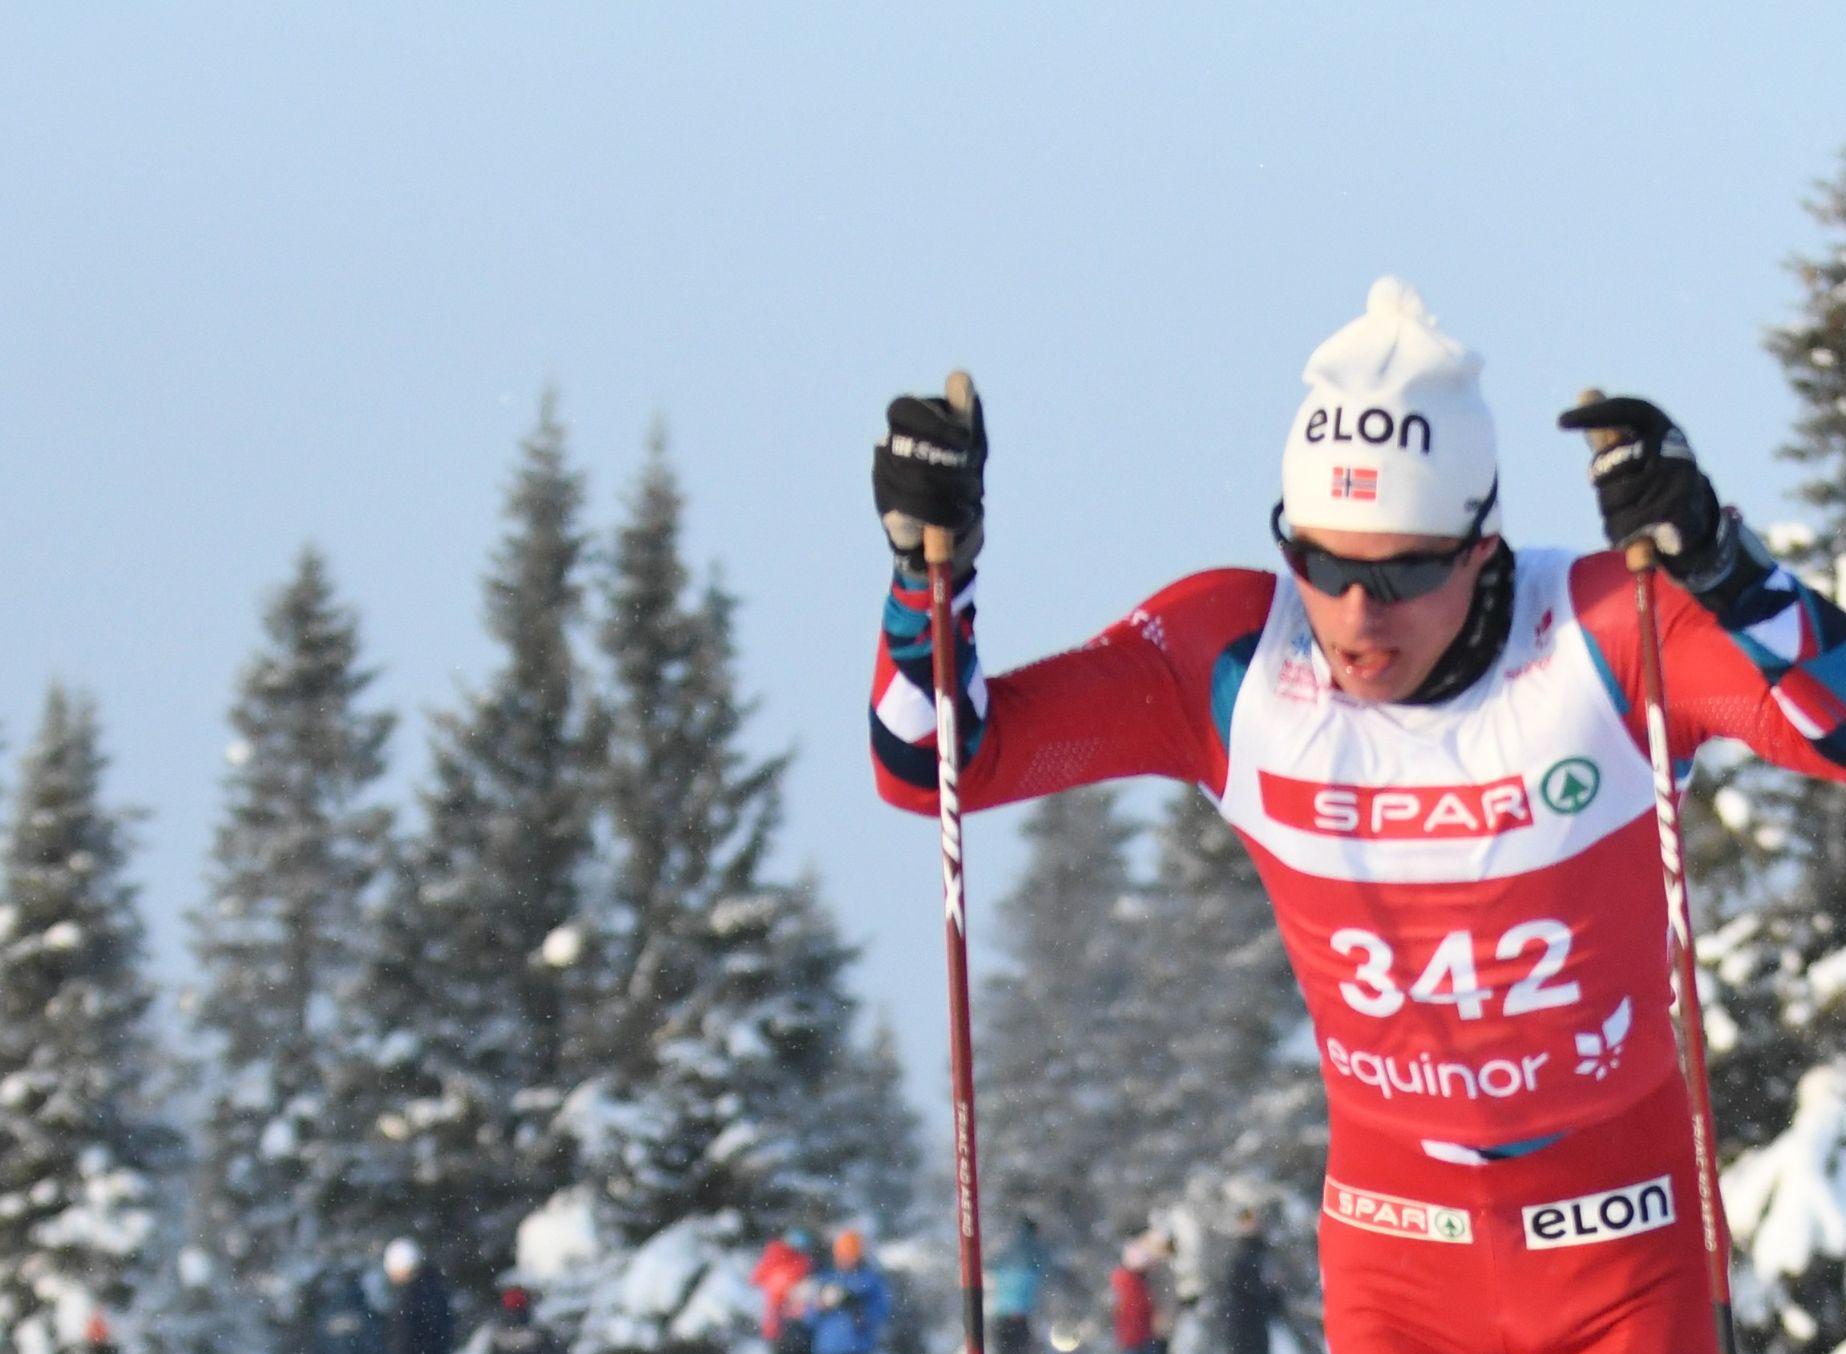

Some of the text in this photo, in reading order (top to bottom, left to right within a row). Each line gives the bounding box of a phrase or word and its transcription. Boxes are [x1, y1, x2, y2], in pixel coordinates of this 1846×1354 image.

[1313, 789, 1527, 834] SPAR
[1329, 918, 1581, 1021] 342
[1326, 1037, 1549, 1099] equinor
[1338, 1193, 1427, 1230] SPAR
